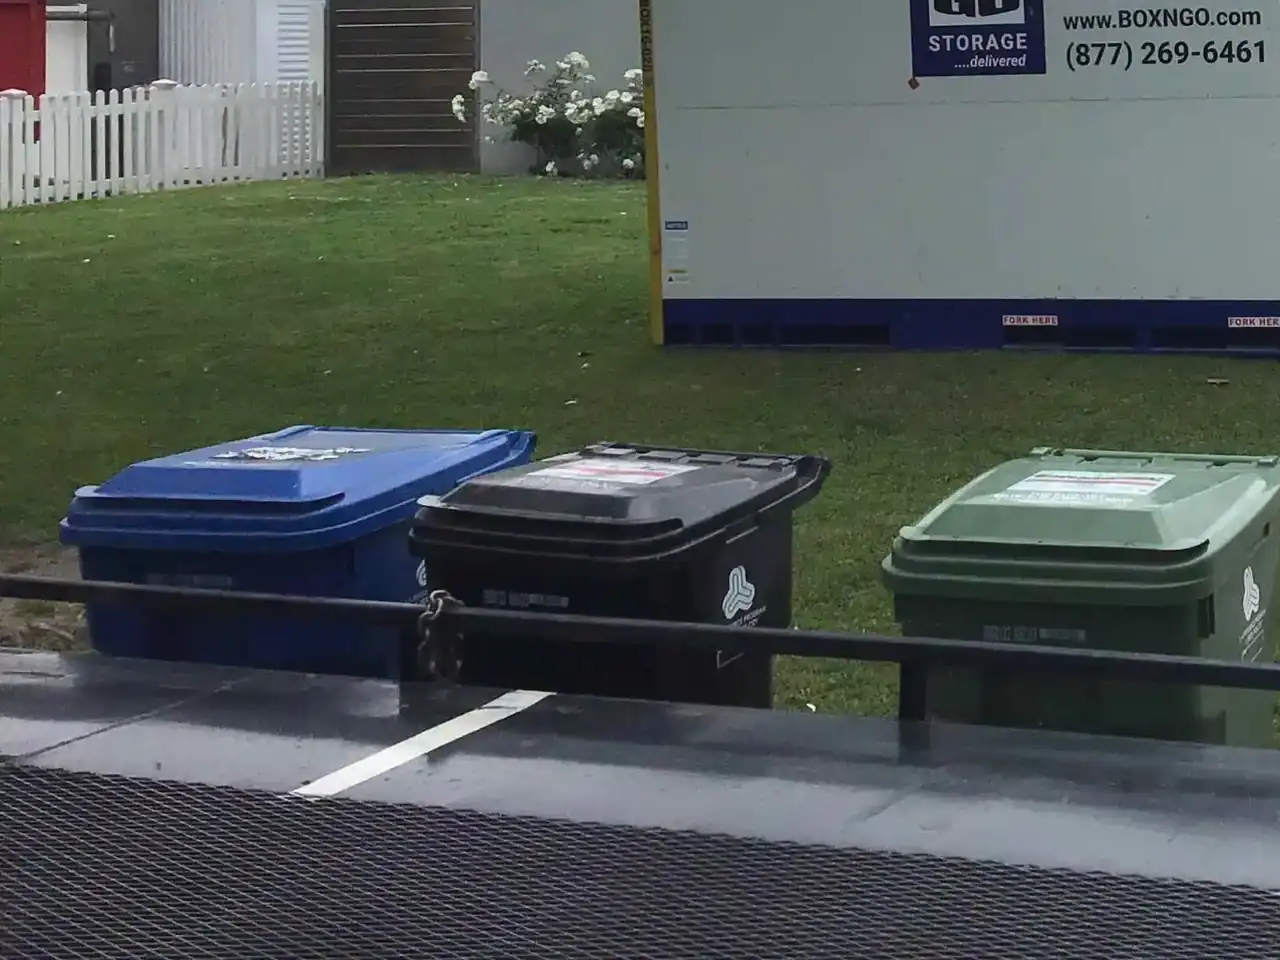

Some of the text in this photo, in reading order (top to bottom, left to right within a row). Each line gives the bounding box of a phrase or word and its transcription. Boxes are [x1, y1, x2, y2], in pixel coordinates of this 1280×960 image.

[1063, 7, 1262, 31] www.BOXNGO.com
[928, 32, 1028, 52] STORAGE
[1066, 40, 1266, 72] (877) 269-6461
[1003, 315, 1029, 325] FORK
[1229, 318, 1256, 327] FORK
